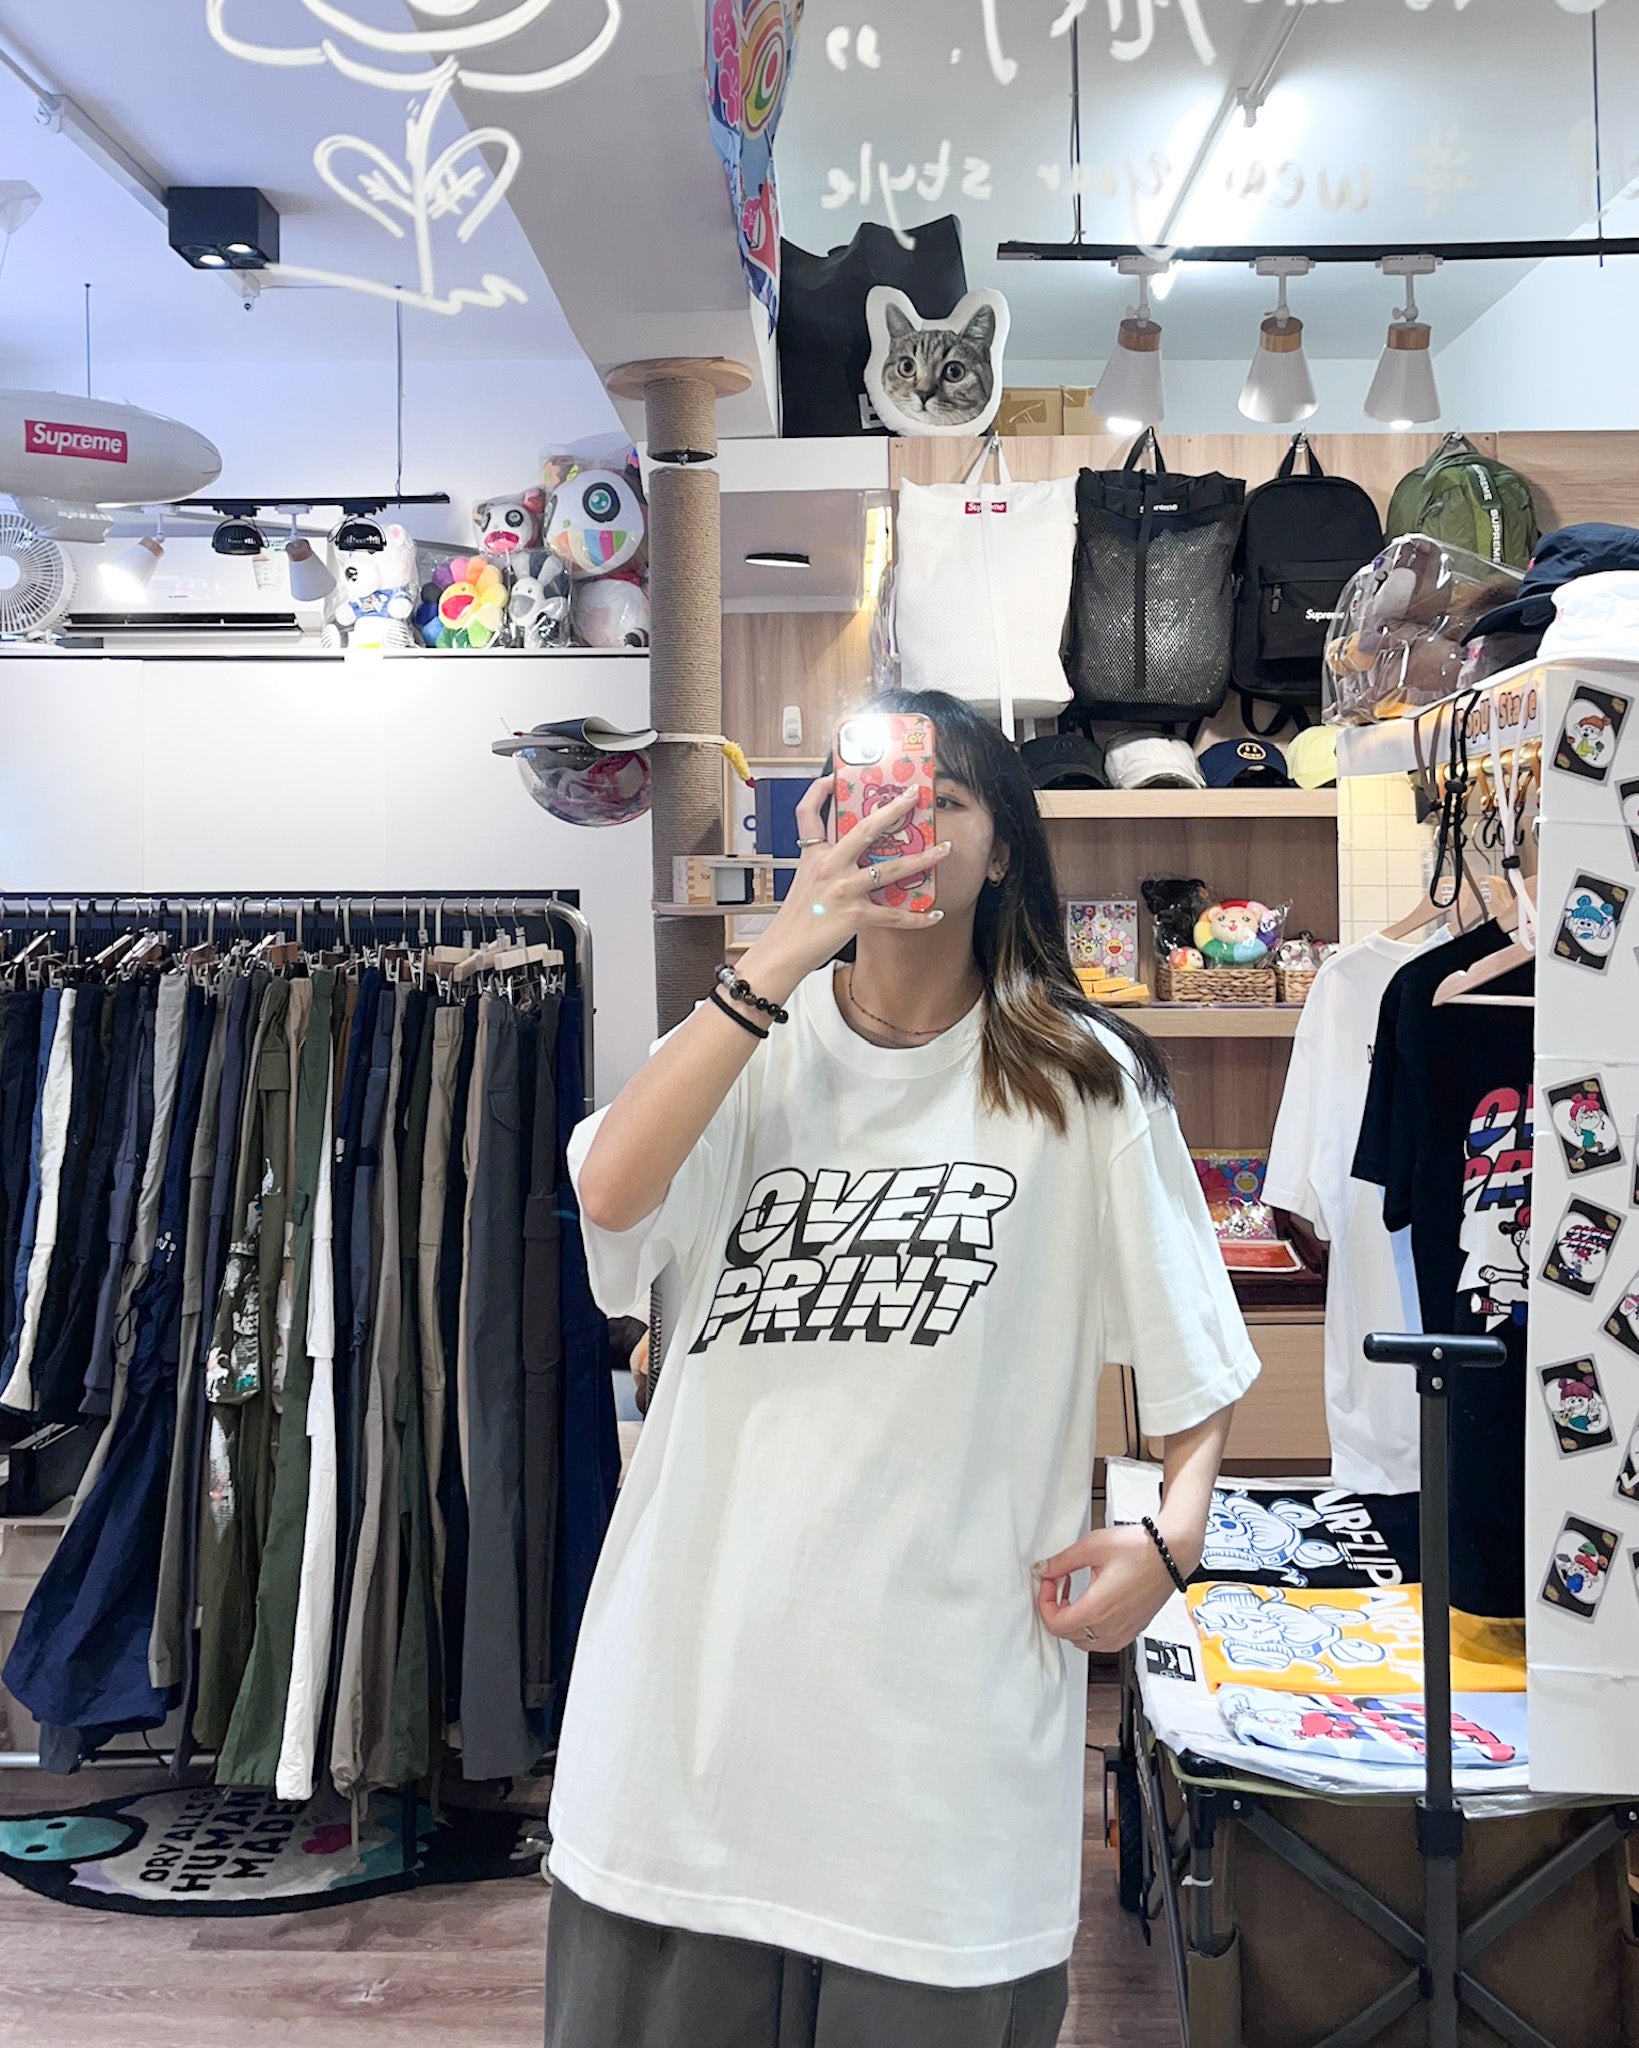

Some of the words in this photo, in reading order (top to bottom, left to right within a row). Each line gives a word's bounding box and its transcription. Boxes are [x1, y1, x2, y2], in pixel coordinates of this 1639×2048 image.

[32, 422, 123, 455] Supreme
[725, 1161, 1017, 1267] OVER
[687, 1254, 998, 1355] PRINT
[171, 1790, 265, 1892] HUMAN
[222, 1800, 307, 1878] MADE
